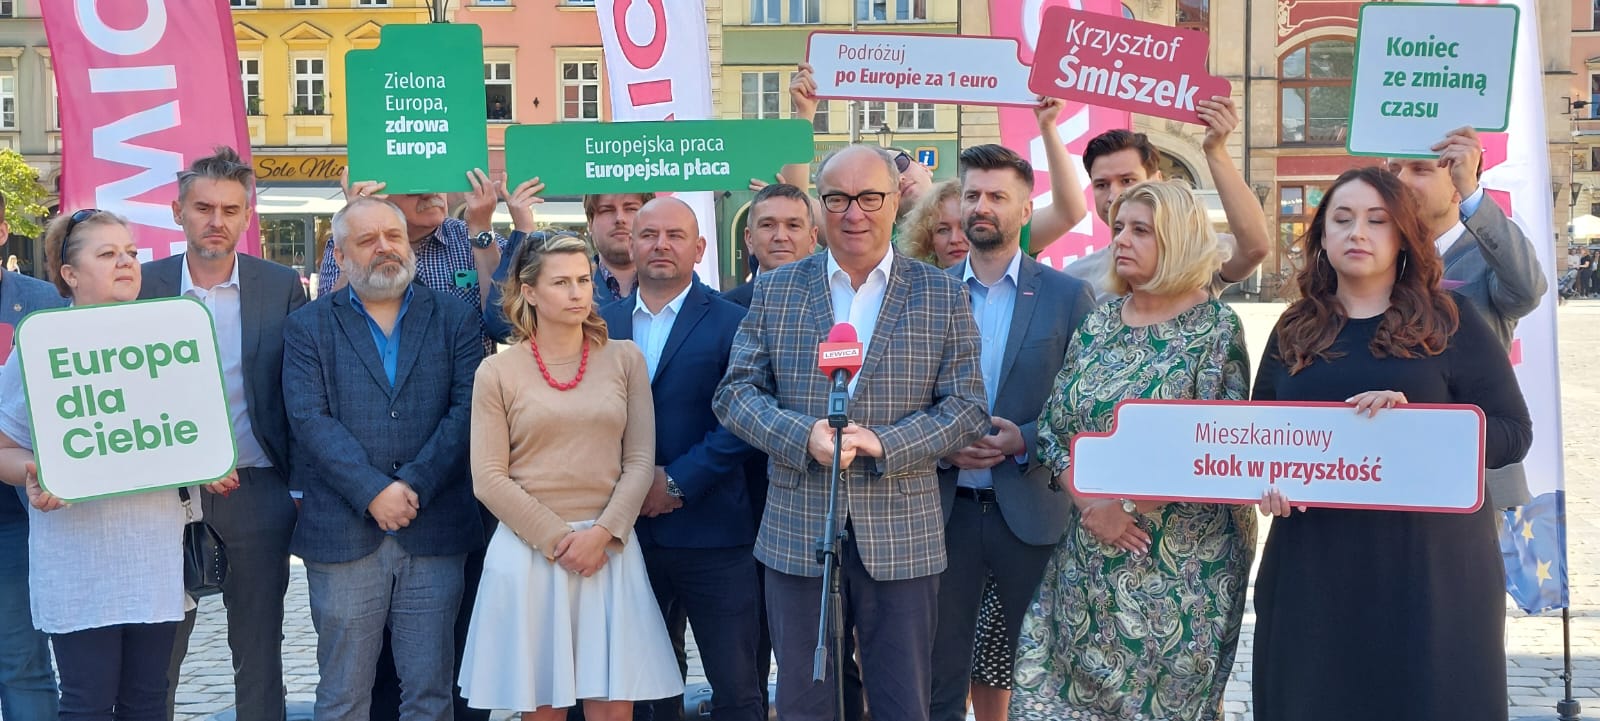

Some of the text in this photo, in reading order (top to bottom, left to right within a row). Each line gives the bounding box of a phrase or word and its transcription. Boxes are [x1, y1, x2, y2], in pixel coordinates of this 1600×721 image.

[1066, 19, 1184, 62] Krzysztof
[1387, 35, 1460, 58] Koniec
[839, 44, 906, 64] Podróżuj
[385, 72, 446, 89] Zielona
[835, 68, 998, 89] po Europie za 1 euro
[1055, 45, 1199, 111] Śmiszek
[1383, 66, 1487, 96] ze zmianą
[386, 96, 448, 114] Europa,
[1381, 101, 1439, 118] czasu
[386, 116, 449, 133] zdrowa
[386, 140, 447, 158] Europa
[585, 135, 725, 159] Europejska praca
[255, 159, 296, 179] Sole
[585, 158, 730, 182] Europejska płaca
[48, 338, 201, 379] Europa
[825, 350, 857, 358] LEWICA
[56, 384, 126, 420] dla
[62, 413, 199, 459] Ciebie
[1195, 422, 1333, 451] Mieszkaniowy
[1194, 454, 1382, 485] skok w przyszłość
